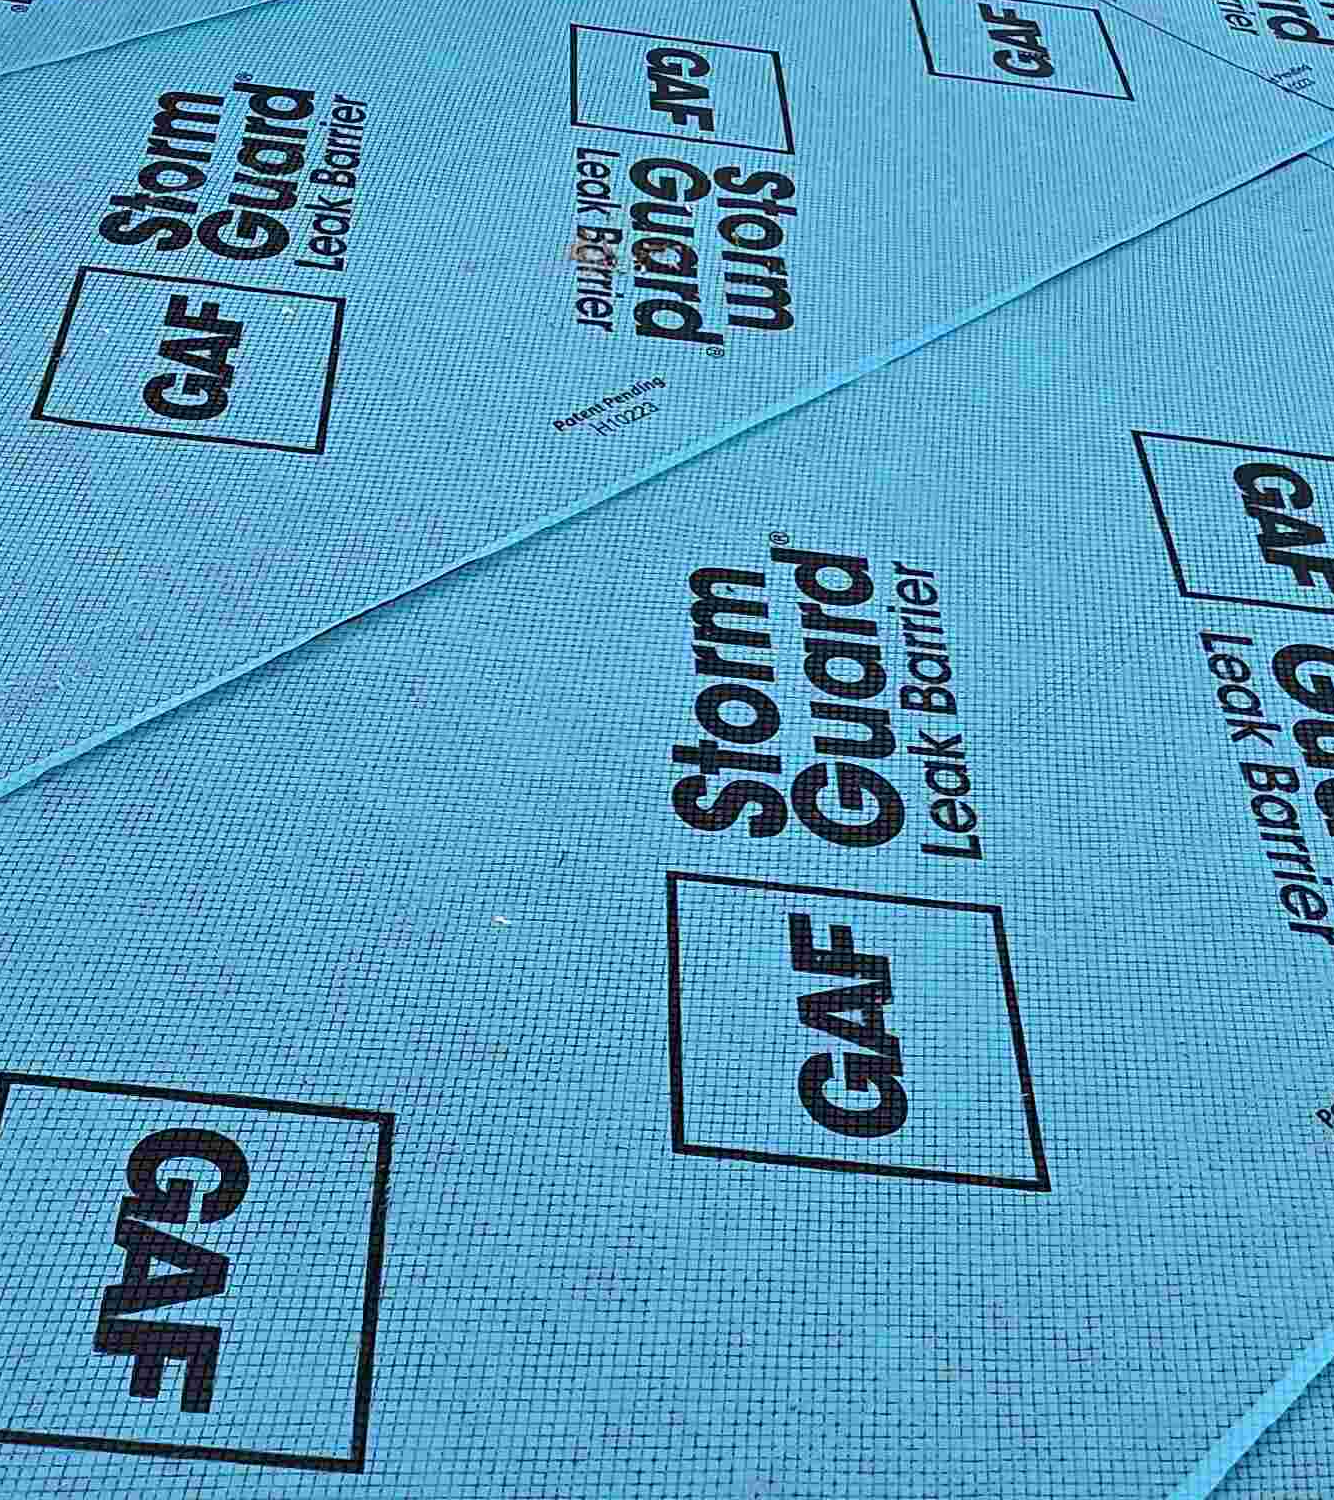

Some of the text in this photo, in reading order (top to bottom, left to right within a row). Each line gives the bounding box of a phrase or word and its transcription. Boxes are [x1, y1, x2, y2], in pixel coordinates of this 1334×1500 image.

[646, 46, 714, 133] GAF
[978, 3, 1055, 78] GAF
[98, 90, 224, 252] Storm
[294, 95, 368, 272] Leak Barrier
[575, 146, 628, 334] Leak Barrier
[714, 165, 797, 334] Storm
[144, 295, 245, 420] GAF
[554, 373, 667, 432] Patent Pending
[671, 566, 789, 839] Storm
[889, 561, 983, 859] Leak Barrier
[1200, 630, 1274, 747] Leak
[789, 912, 908, 1139] GAF
[94, 1128, 249, 1413] GAF
